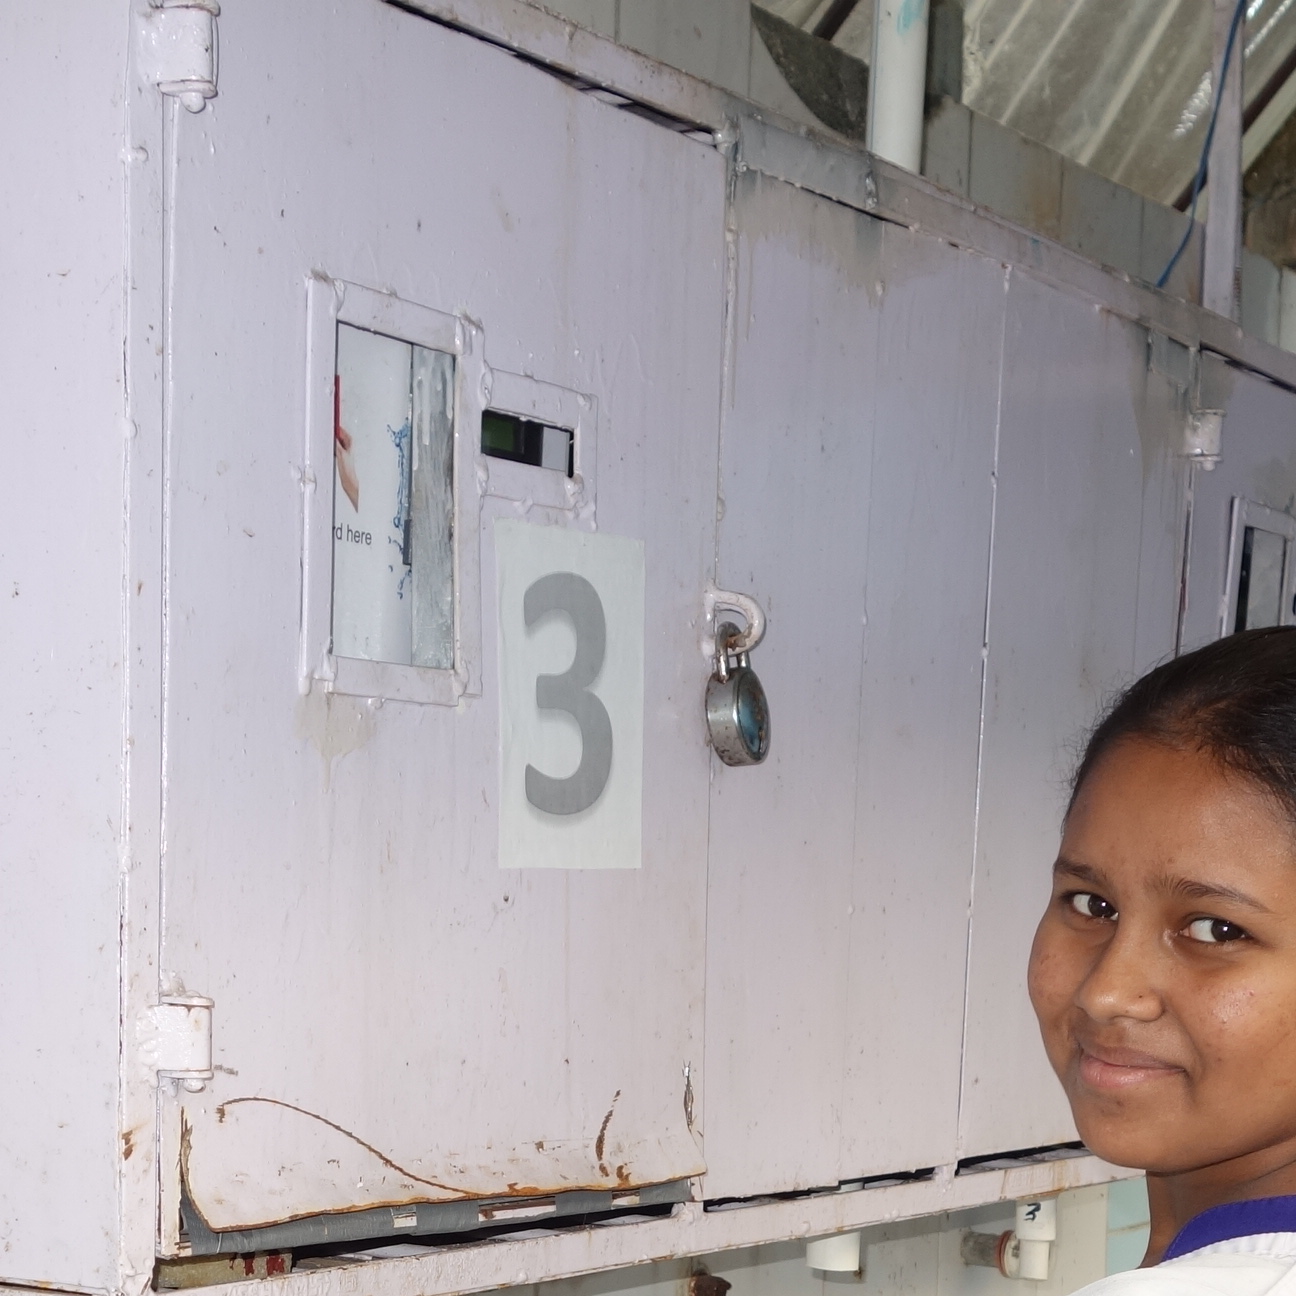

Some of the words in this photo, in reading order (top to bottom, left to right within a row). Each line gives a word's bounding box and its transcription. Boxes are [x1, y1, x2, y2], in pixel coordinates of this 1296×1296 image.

[333, 522, 343, 540] d
[346, 523, 372, 546] here
[524, 571, 613, 815] 3
